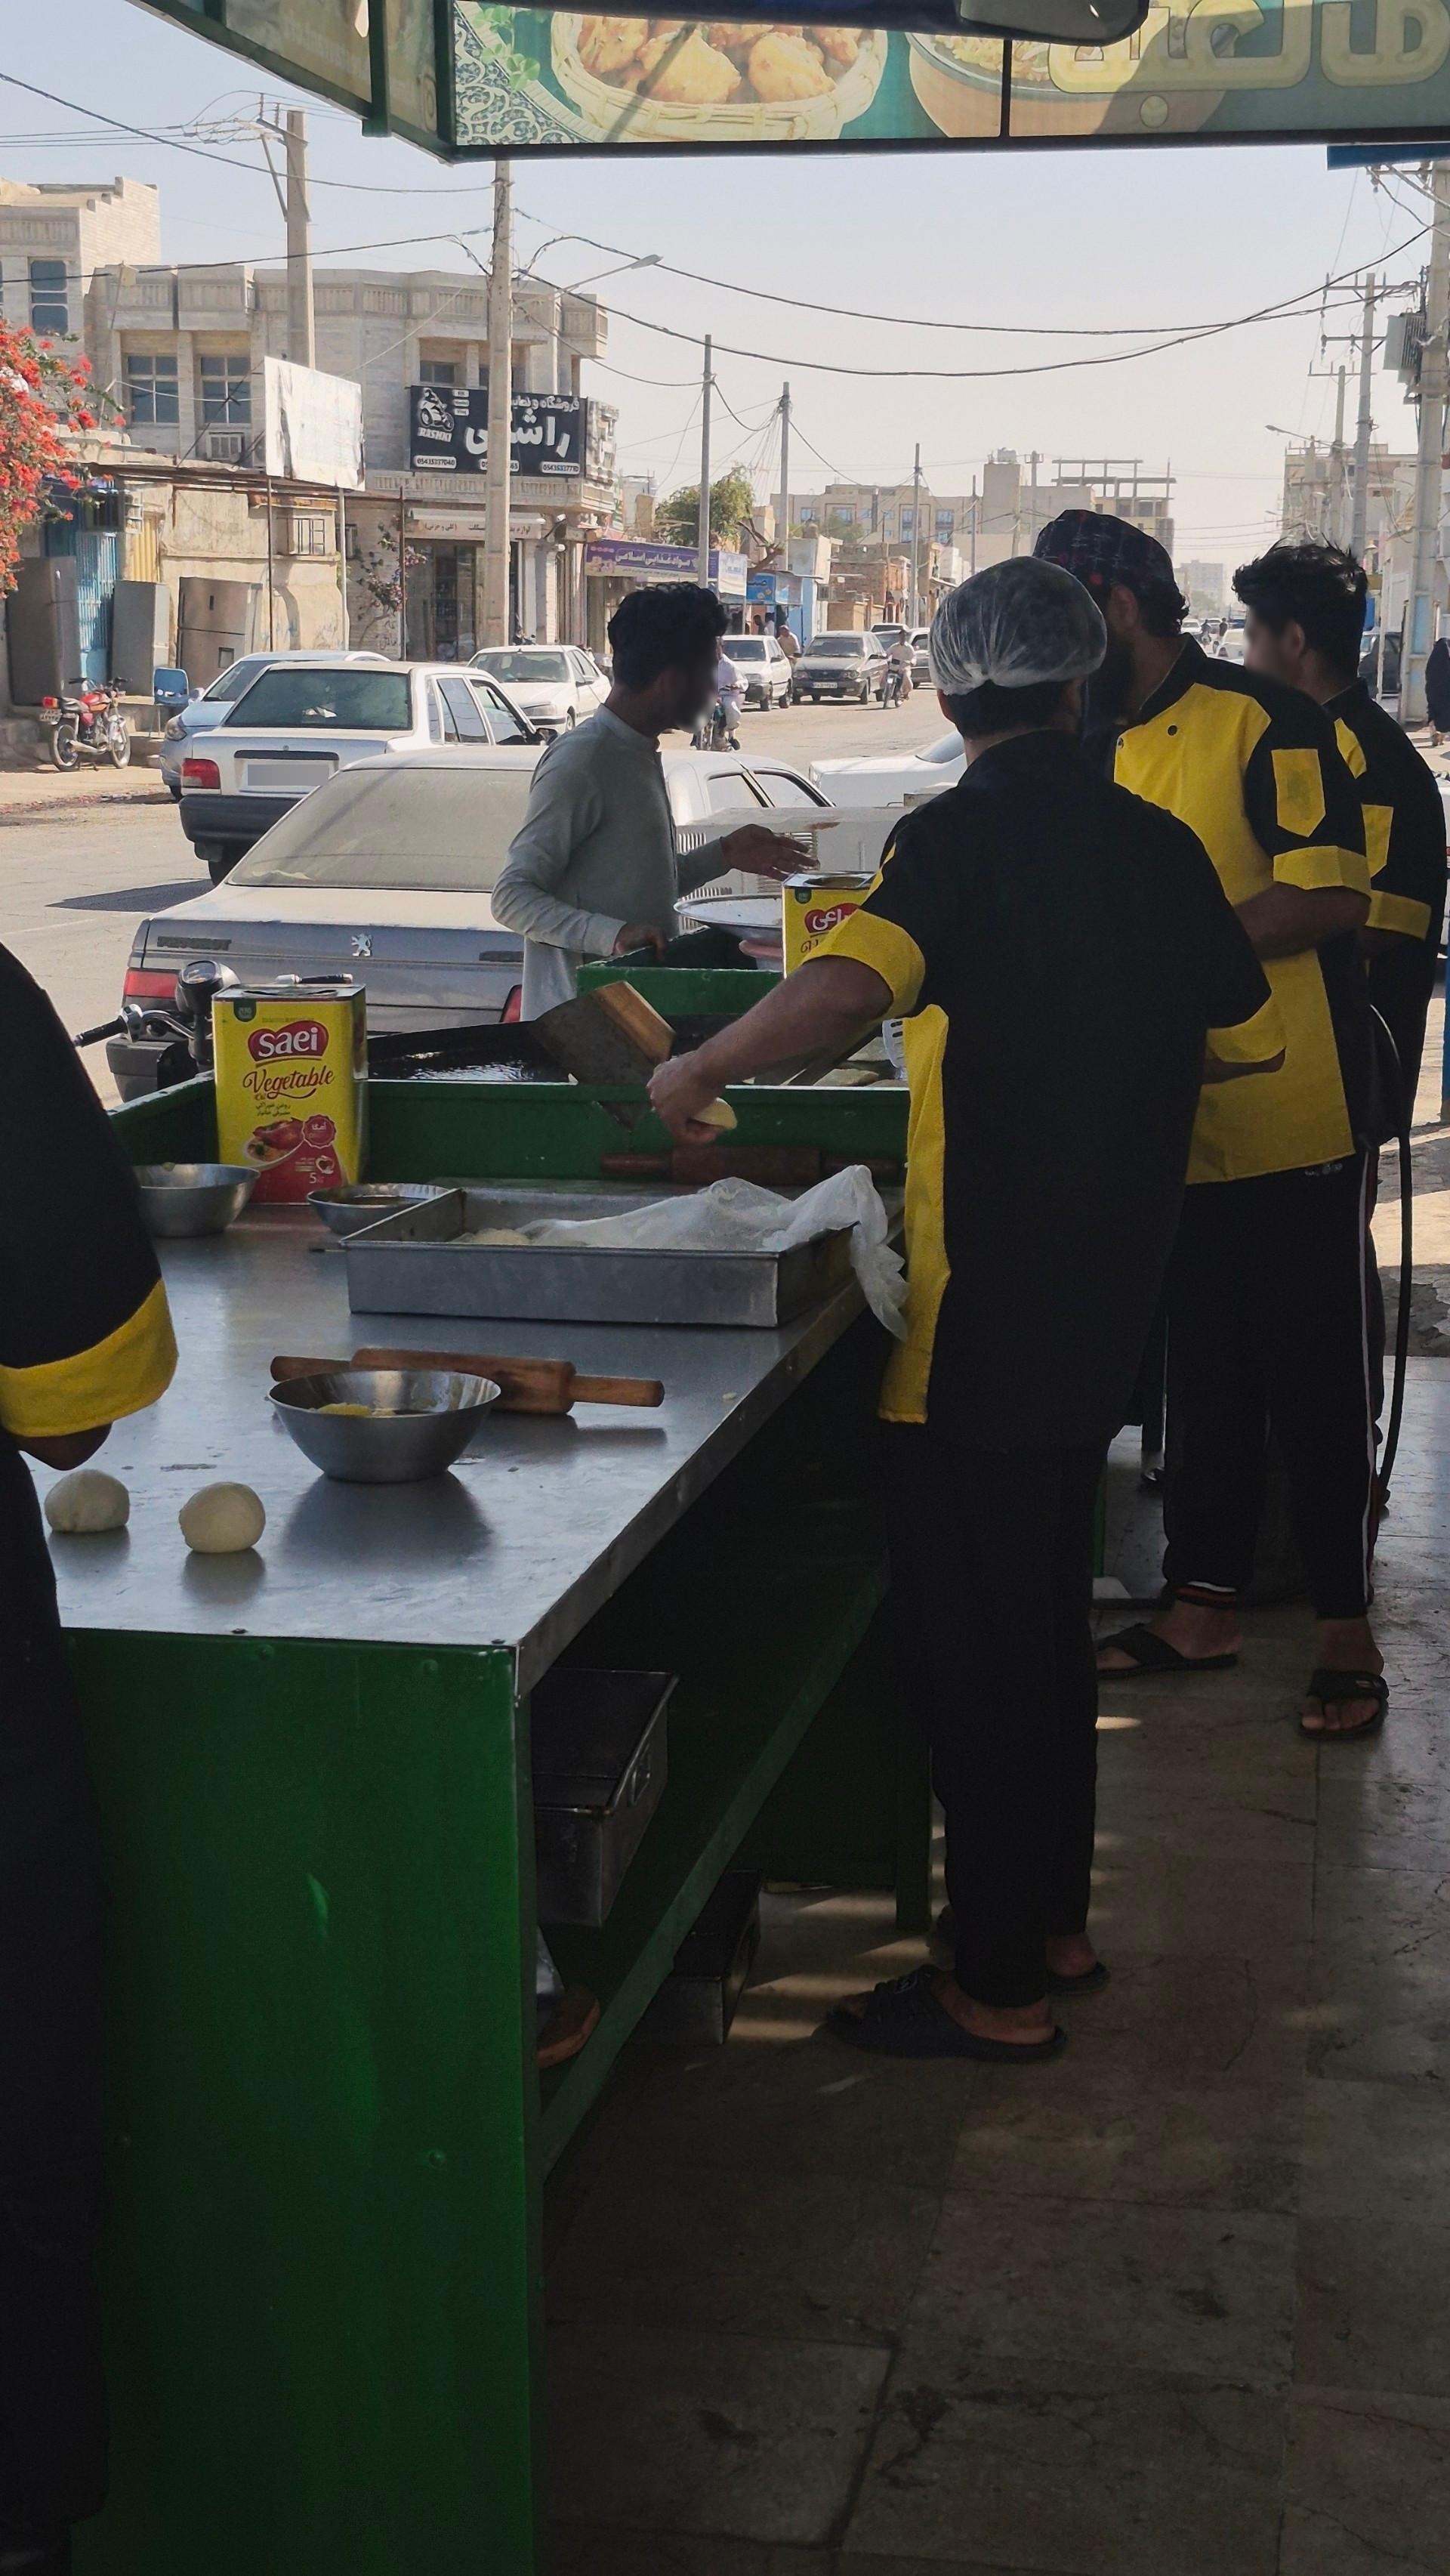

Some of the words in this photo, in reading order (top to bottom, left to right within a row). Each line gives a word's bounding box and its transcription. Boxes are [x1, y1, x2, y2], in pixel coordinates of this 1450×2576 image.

[540, 396, 579, 412] فروشگاه
[813, 908, 850, 931] اعی
[258, 1027, 318, 1058] saei
[242, 1065, 335, 1100] Vegetable
[309, 1172, 317, 1184] 5
